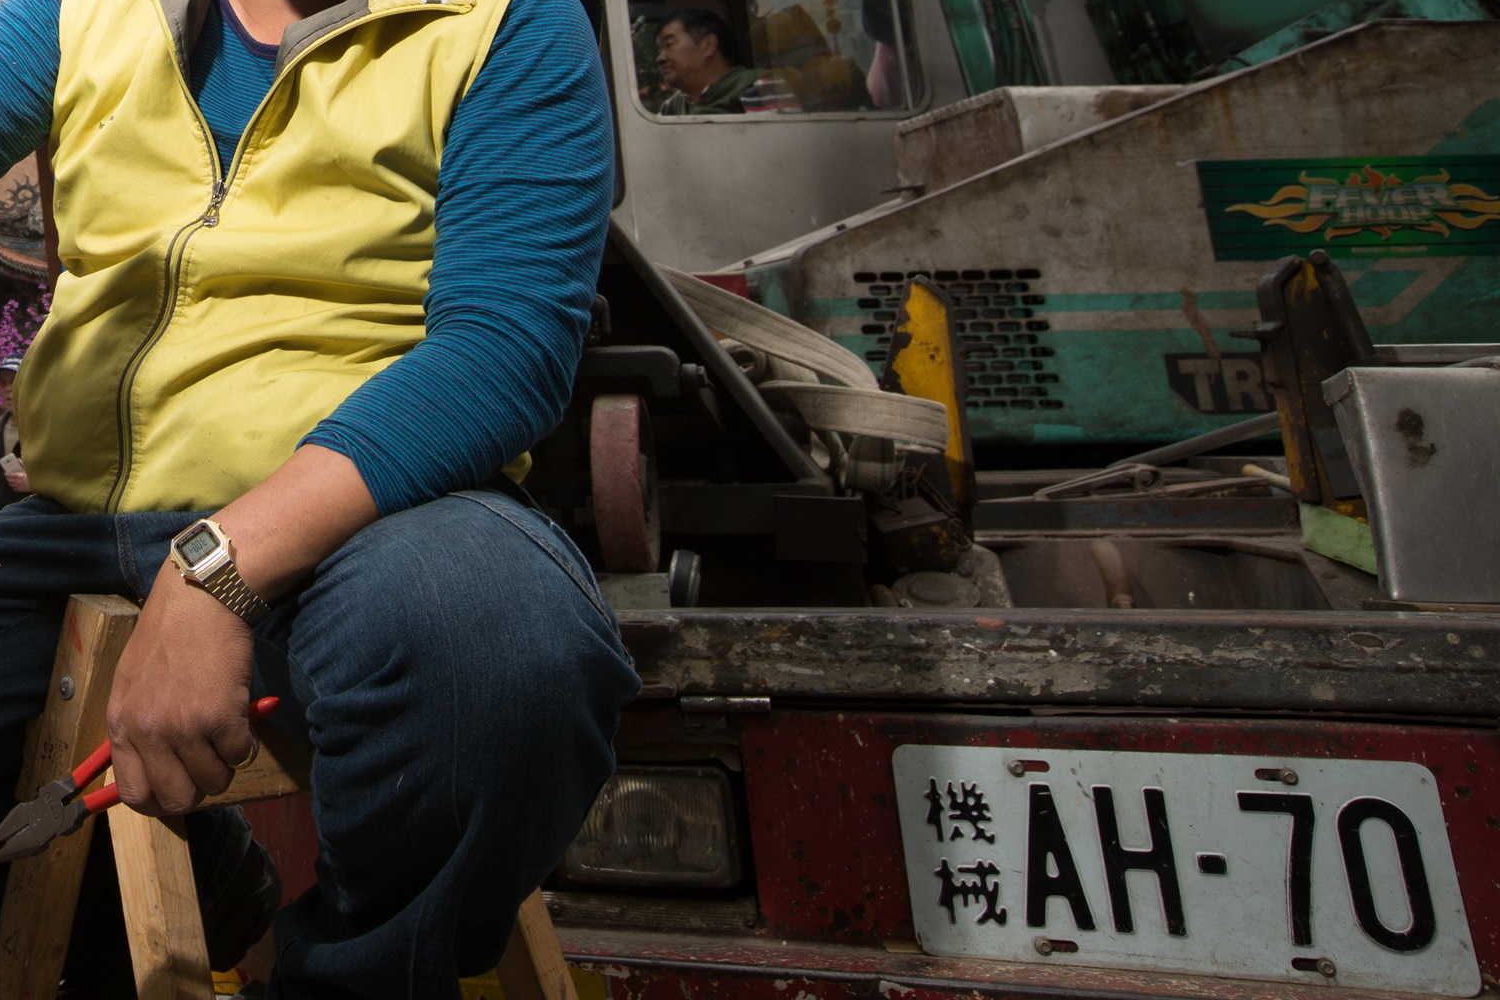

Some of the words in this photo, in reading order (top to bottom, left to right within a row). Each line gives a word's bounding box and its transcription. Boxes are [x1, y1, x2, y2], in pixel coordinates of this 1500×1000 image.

[1308, 182, 1455, 209] FEVER
[1341, 205, 1431, 223] HOOP
[1178, 359, 1273, 411] TR
[925, 777, 1008, 926] 機械
[1025, 781, 1437, 953] AH-70
